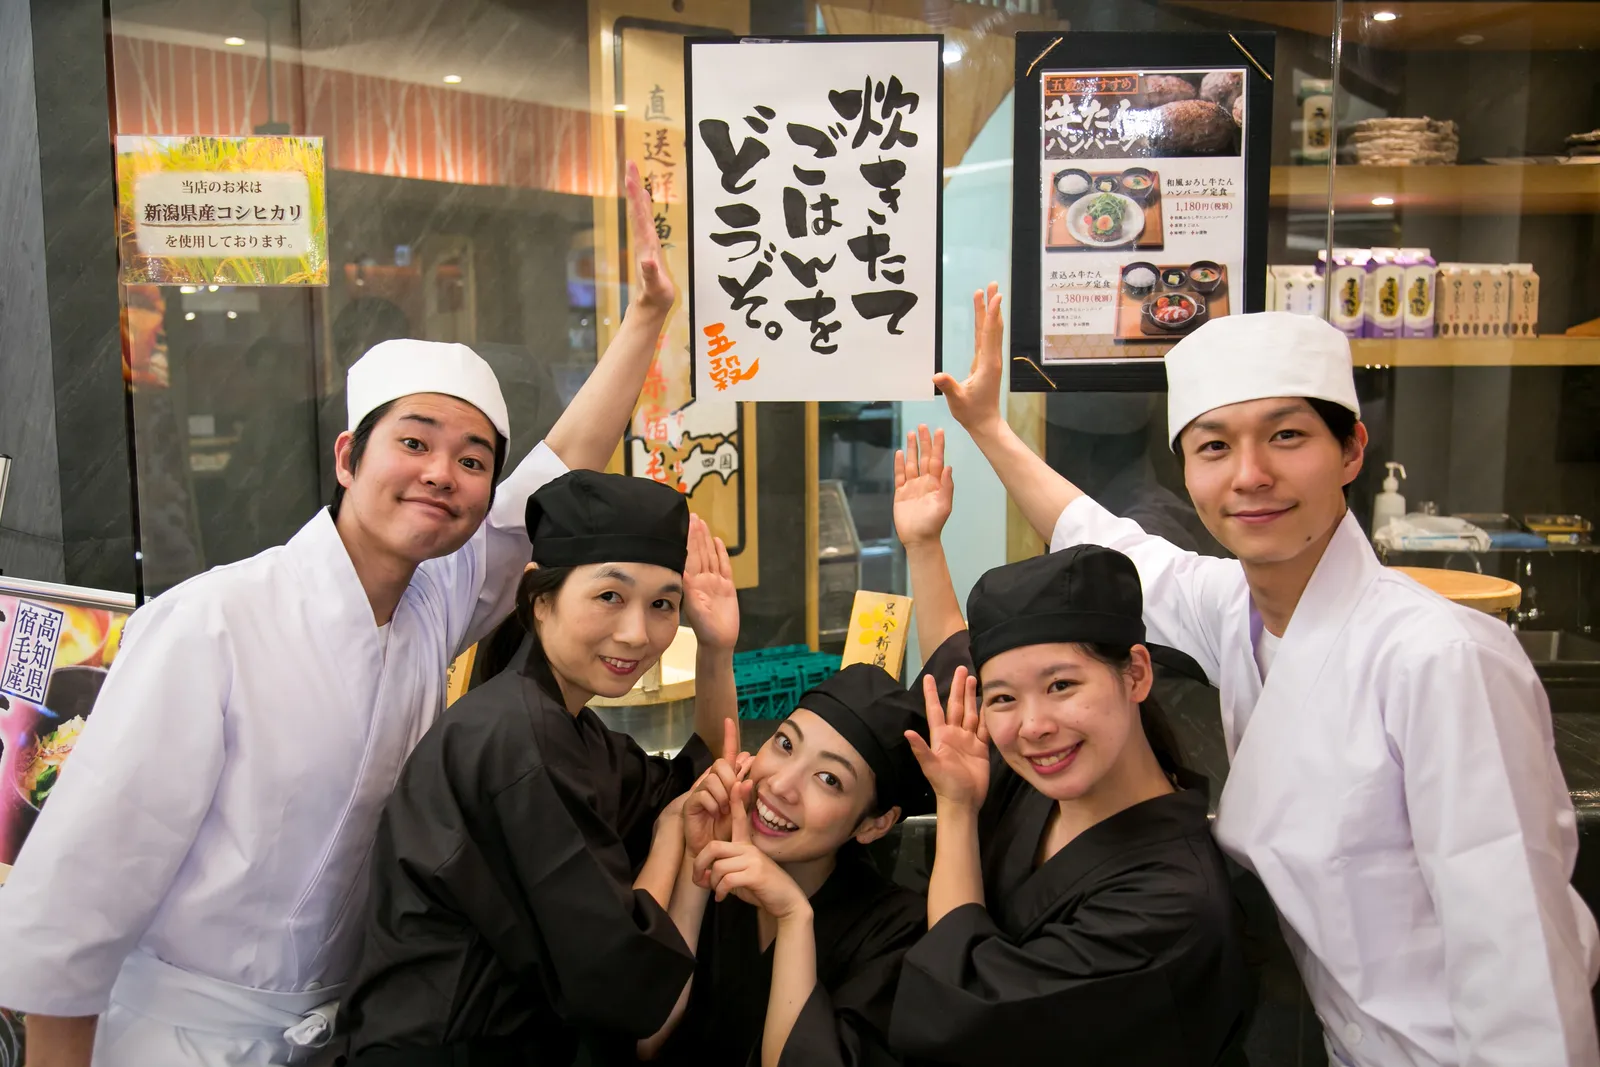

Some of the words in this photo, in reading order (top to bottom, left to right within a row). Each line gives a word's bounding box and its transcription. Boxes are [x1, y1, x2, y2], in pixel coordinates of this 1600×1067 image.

[181, 180, 262, 194] 当店のお米は
[1167, 178, 1234, 187] 和風おろし牛たん
[1167, 187, 1227, 196] ハンバーグ定食
[828, 75, 919, 335] 炊きたて
[144, 204, 302, 222] 新潟県産コシヒカリ
[698, 105, 783, 340] どうぞ。
[165, 235, 293, 249] を使用しております。
[781, 122, 847, 354] ごはんを
[1050, 270, 1102, 279] 煮込み牛たん
[1051, 280, 1111, 289] ハンバーグ定食
[702, 454, 732, 469] 四国
[4, 606, 39, 692] 宿毛産
[23, 611, 60, 699] 高知県
